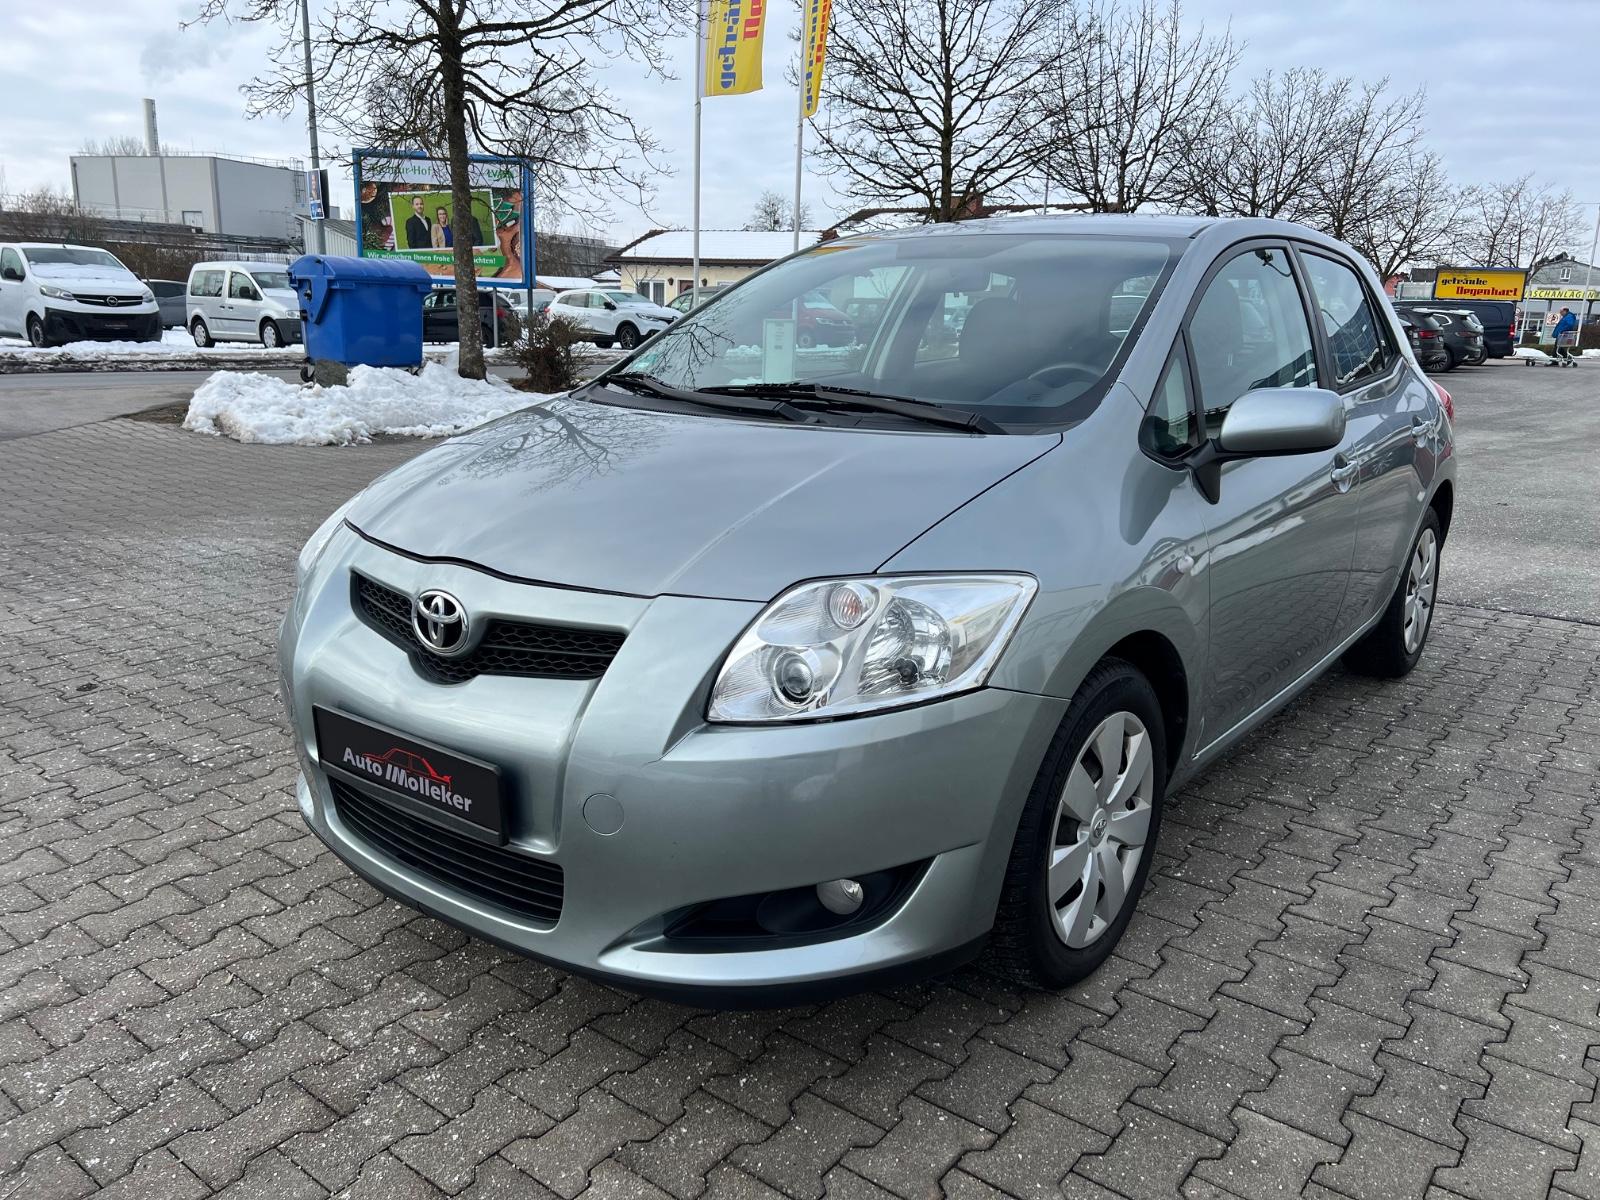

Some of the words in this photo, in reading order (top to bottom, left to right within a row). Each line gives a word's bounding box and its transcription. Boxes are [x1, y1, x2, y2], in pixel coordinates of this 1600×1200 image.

[413, 253, 432, 261] Ihnen
[433, 254, 451, 262] frohe
[343, 747, 383, 776] Auto
[385, 763, 472, 812] Molleker
